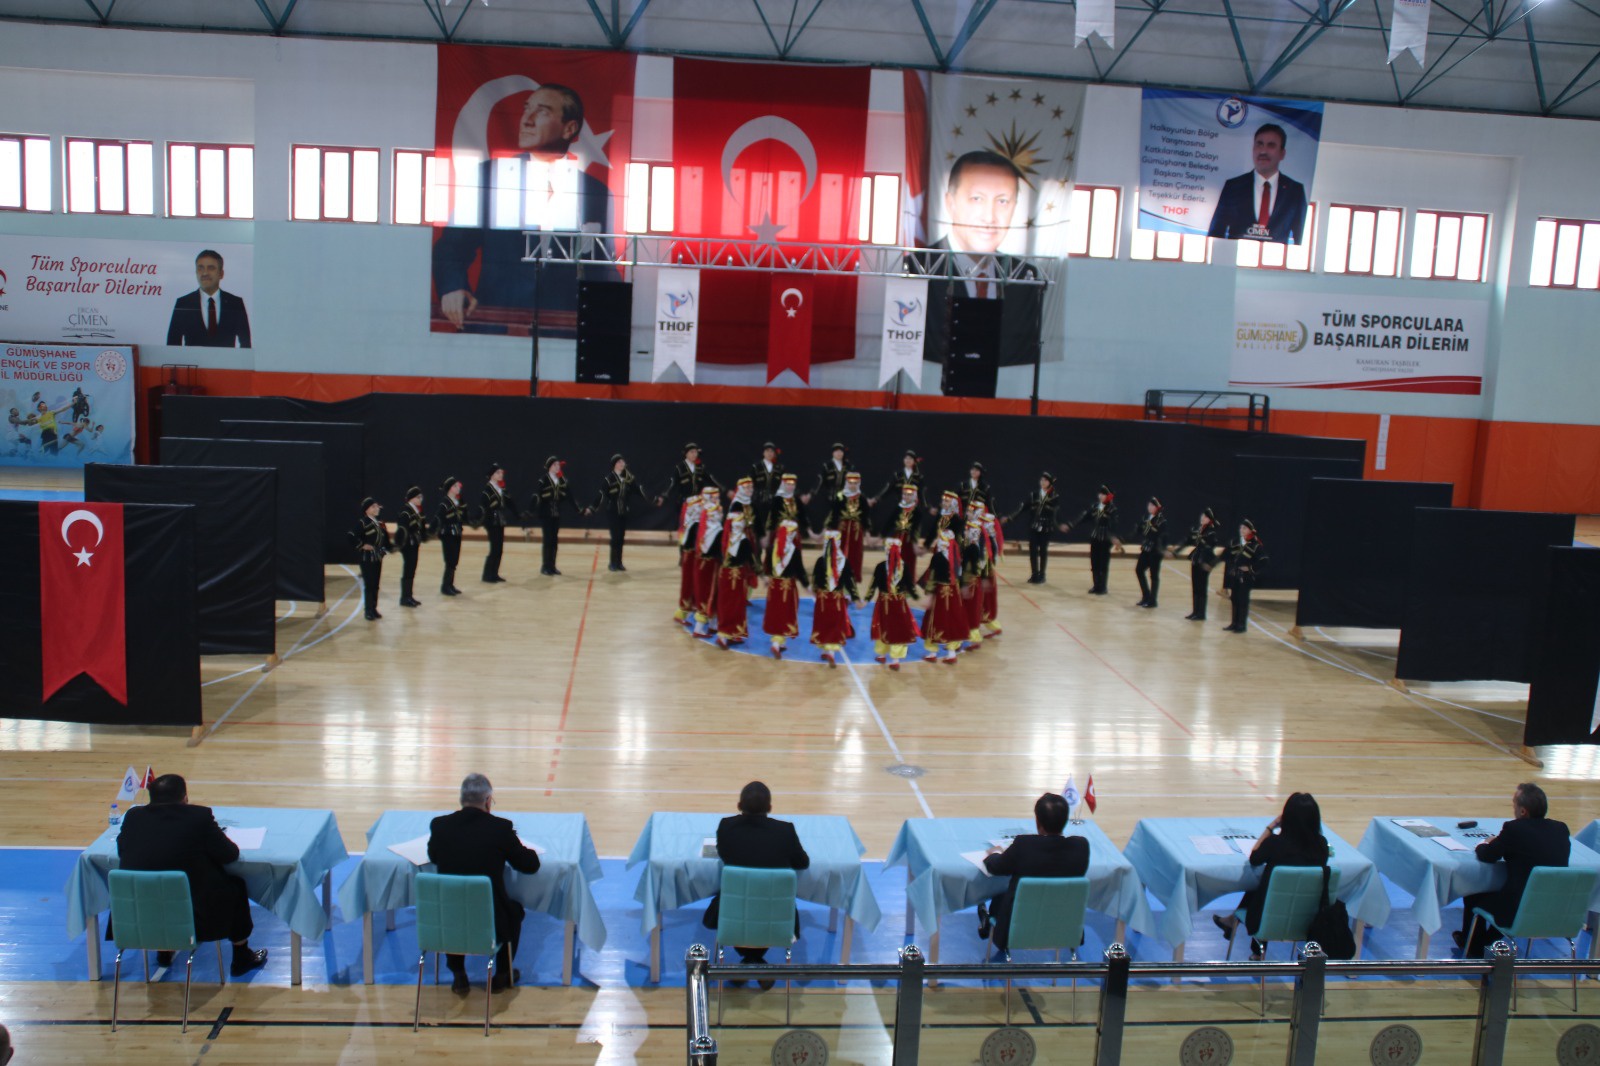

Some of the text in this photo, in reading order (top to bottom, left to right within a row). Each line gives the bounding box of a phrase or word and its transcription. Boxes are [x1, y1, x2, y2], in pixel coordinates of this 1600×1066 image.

[1142, 155, 1219, 173] Gümüşhane Belediye
[1154, 168, 1206, 182] Başkanı Sayın
[1153, 179, 1174, 188] Ercan
[1148, 189, 1181, 200] Teşekkür
[1162, 205, 1190, 216] THOF
[31, 254, 158, 277] Tüm Sporculara
[26, 275, 162, 297] Başarılar Dilerim
[658, 320, 694, 332] THOF
[1322, 309, 1465, 333] TÜM SPORCULARA
[886, 329, 922, 341] THOF
[1236, 328, 1298, 344] GÜMÜŞHANE
[1313, 331, 1470, 353] BAŞARILAR DİLERİM
[6, 347, 77, 359] GÜMÜŞHANE
[43, 361, 58, 370] VE
[60, 361, 91, 371] SPOR
[13, 370, 83, 383] MÜDÜRLÜĞÜ
